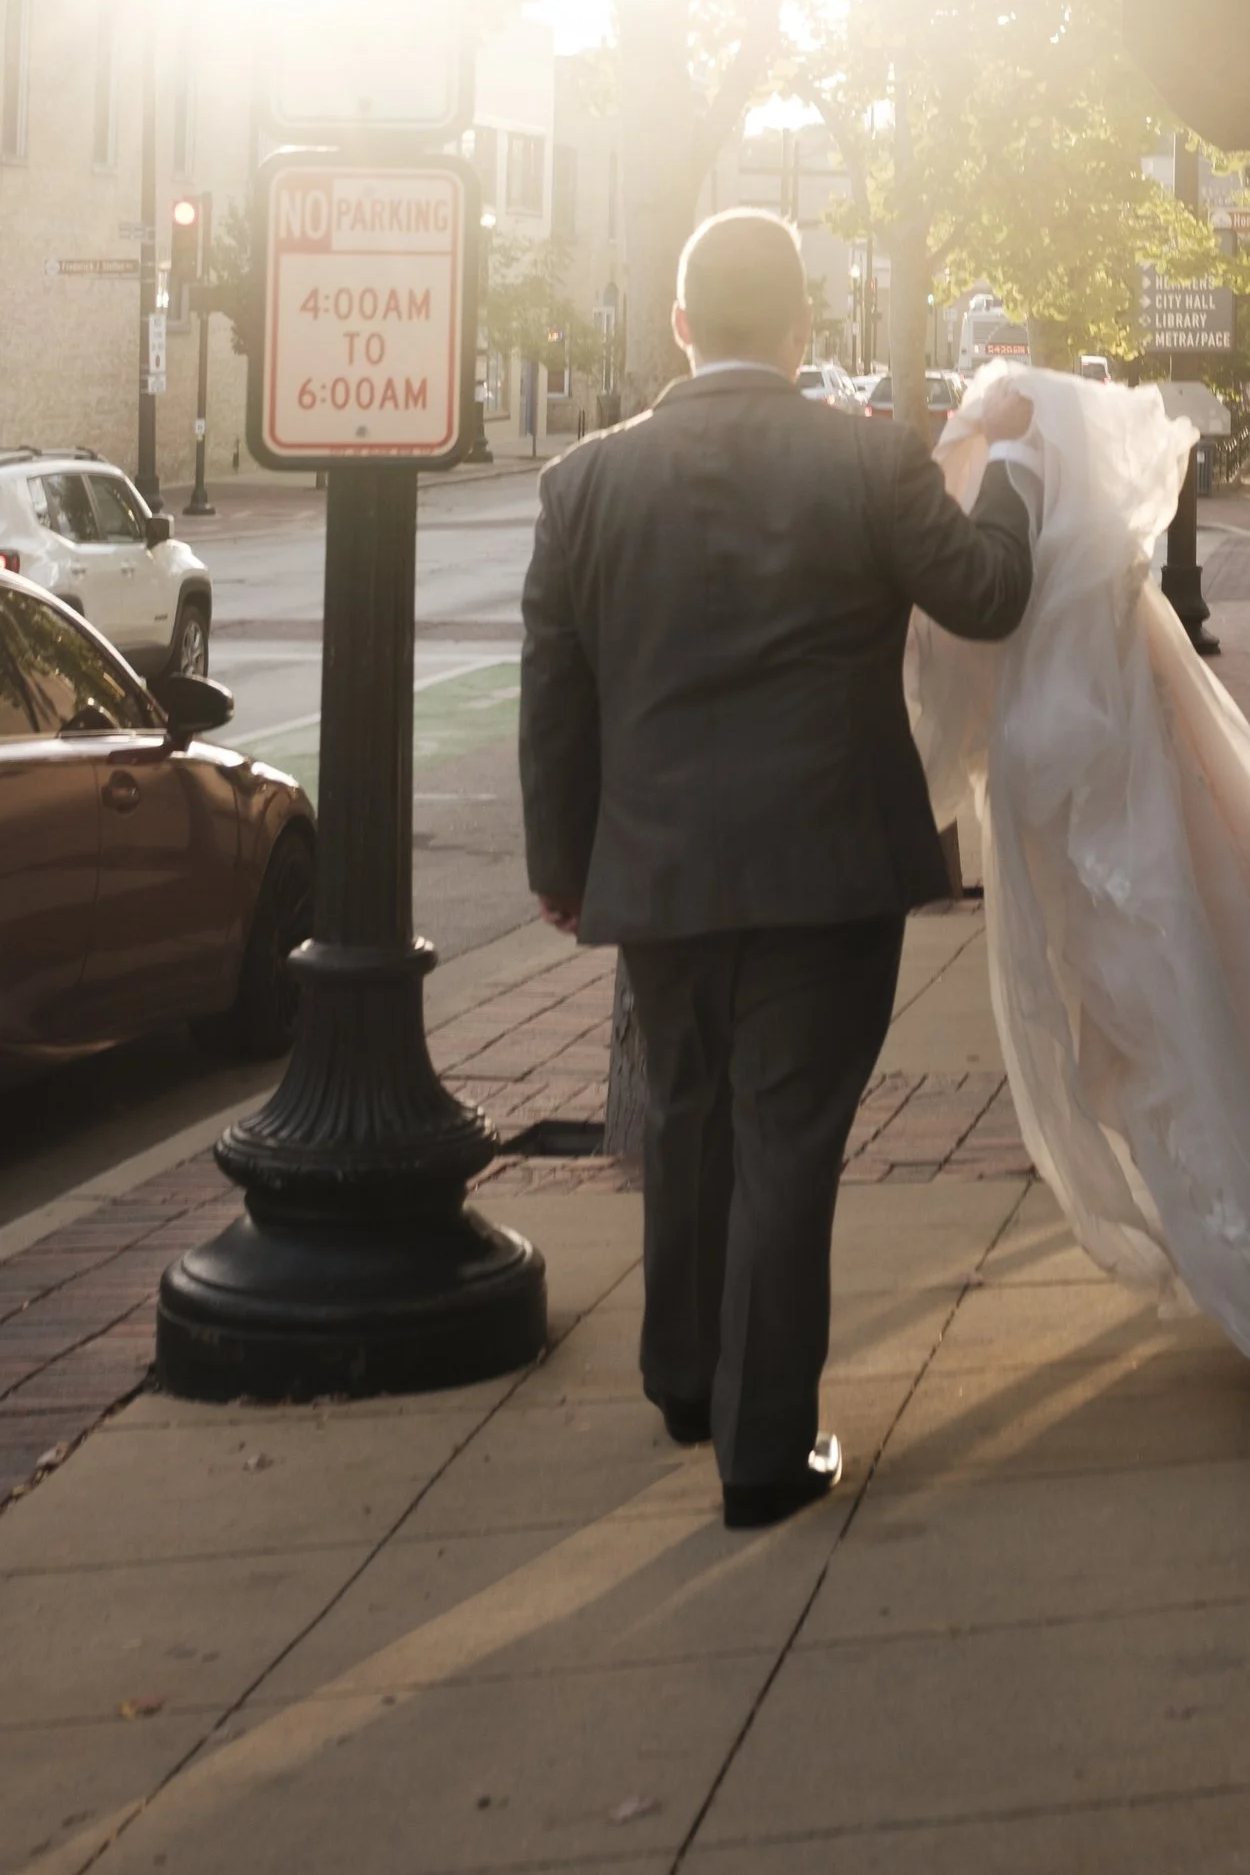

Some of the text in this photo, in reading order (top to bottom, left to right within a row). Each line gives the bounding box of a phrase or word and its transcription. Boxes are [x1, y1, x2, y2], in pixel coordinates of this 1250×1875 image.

[280, 190, 449, 240] NO PARKING
[299, 288, 431, 321] 4:00AM
[1155, 293, 1216, 309] CITY HALL
[1155, 312, 1207, 328] LIBRARY
[343, 333, 386, 365] TO
[1155, 331, 1231, 347] METRA/PACE
[298, 378, 428, 411] 6:00AM
